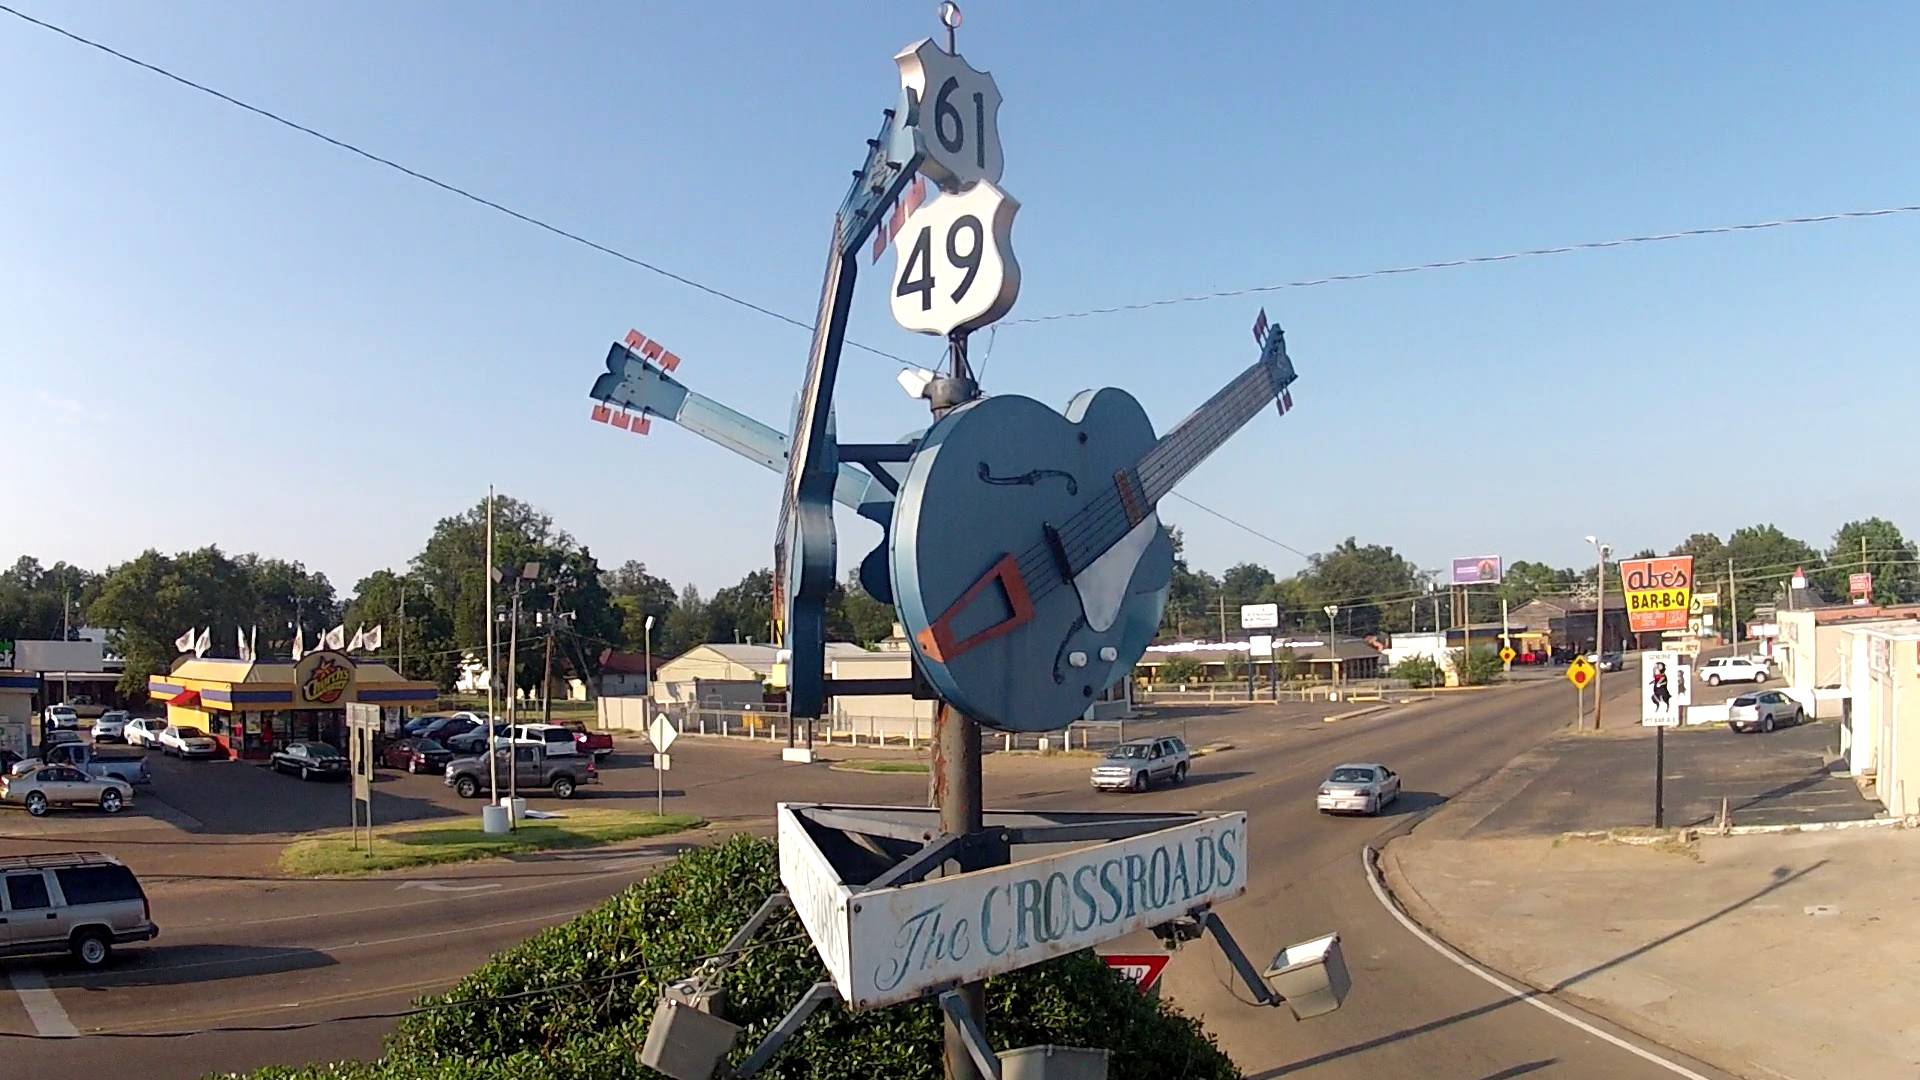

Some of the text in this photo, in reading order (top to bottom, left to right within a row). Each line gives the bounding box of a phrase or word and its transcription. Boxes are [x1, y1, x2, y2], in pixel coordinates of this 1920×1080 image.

[934, 76, 985, 169] 61
[896, 214, 984, 311] 49
[1627, 563, 1688, 590] abe's
[1631, 591, 1685, 610] BAR-B-Q
[873, 903, 970, 992] The
[980, 829, 1238, 957] CROSSROADS
